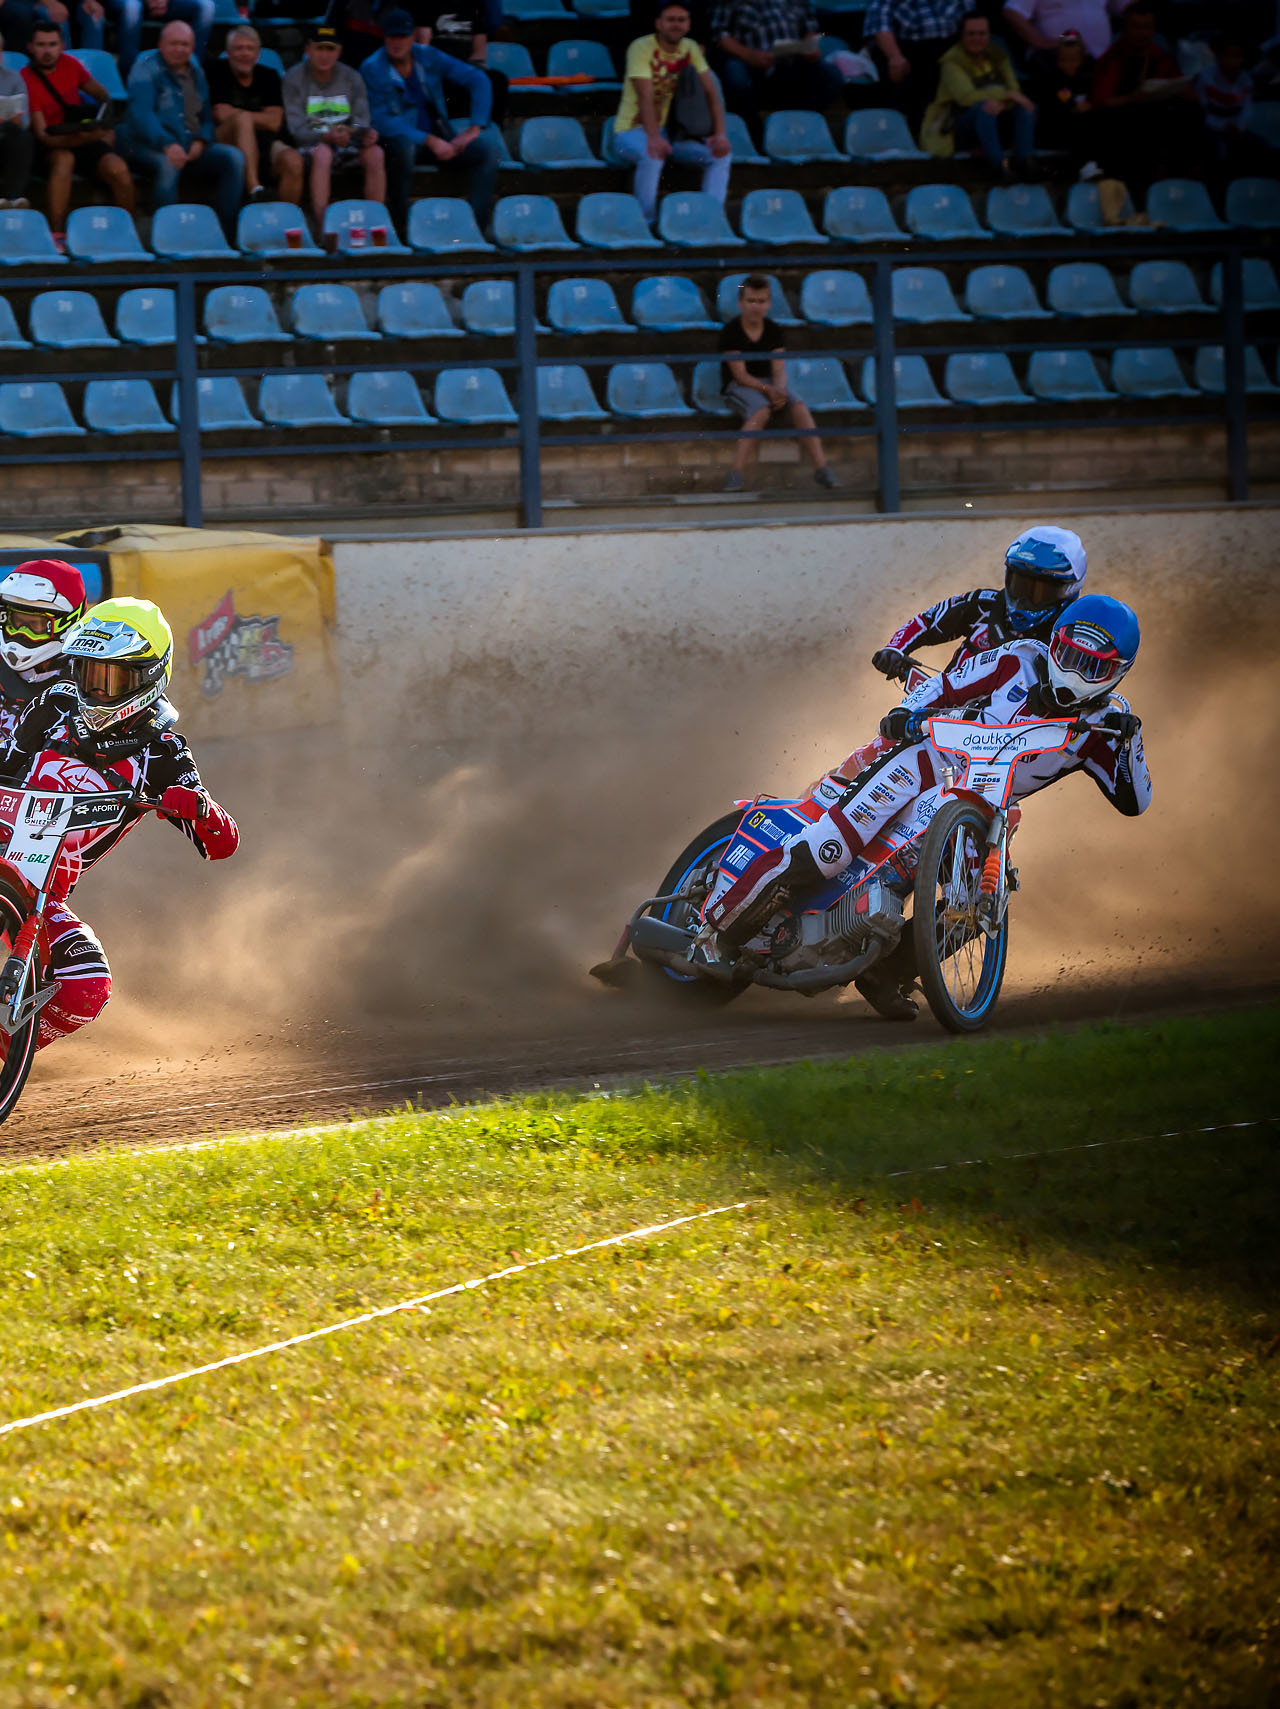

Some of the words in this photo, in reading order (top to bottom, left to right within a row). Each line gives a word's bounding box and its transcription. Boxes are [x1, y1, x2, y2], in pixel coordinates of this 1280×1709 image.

[71, 638, 102, 648] MAT
[1076, 638, 1094, 648] BELL
[62, 685, 78, 696] HA
[119, 691, 156, 720] HIL-GAZ
[894, 767, 914, 786] ERGOSS
[874, 785, 896, 802] ERGOSS
[92, 804, 119, 812] AFORTI
[856, 804, 877, 821] ERGOSS
[7, 851, 51, 864] HIL-GAZ
